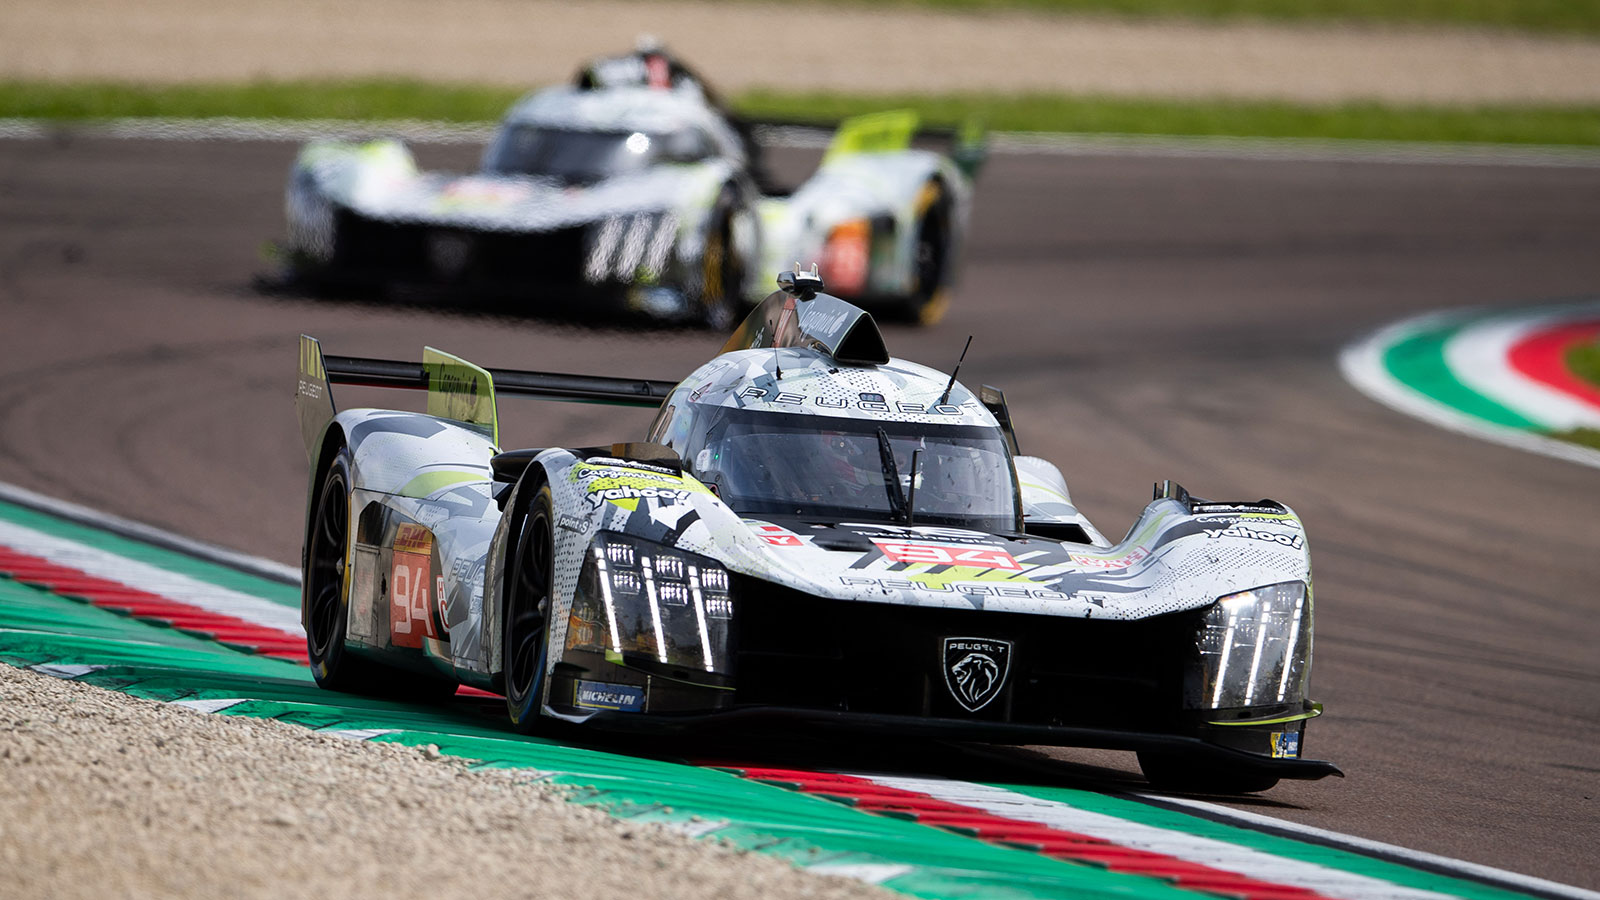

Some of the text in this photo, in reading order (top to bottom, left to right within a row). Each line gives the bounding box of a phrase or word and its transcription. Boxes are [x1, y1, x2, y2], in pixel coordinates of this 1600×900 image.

[739, 386, 979, 416] PEUGEOT
[586, 485, 691, 511] yahoo!
[1203, 526, 1304, 550] yahoo!
[884, 545, 1015, 568] 94
[393, 564, 434, 636] 94
[839, 576, 1107, 604] PEUGEOT
[582, 690, 636, 705] MICHELIN
